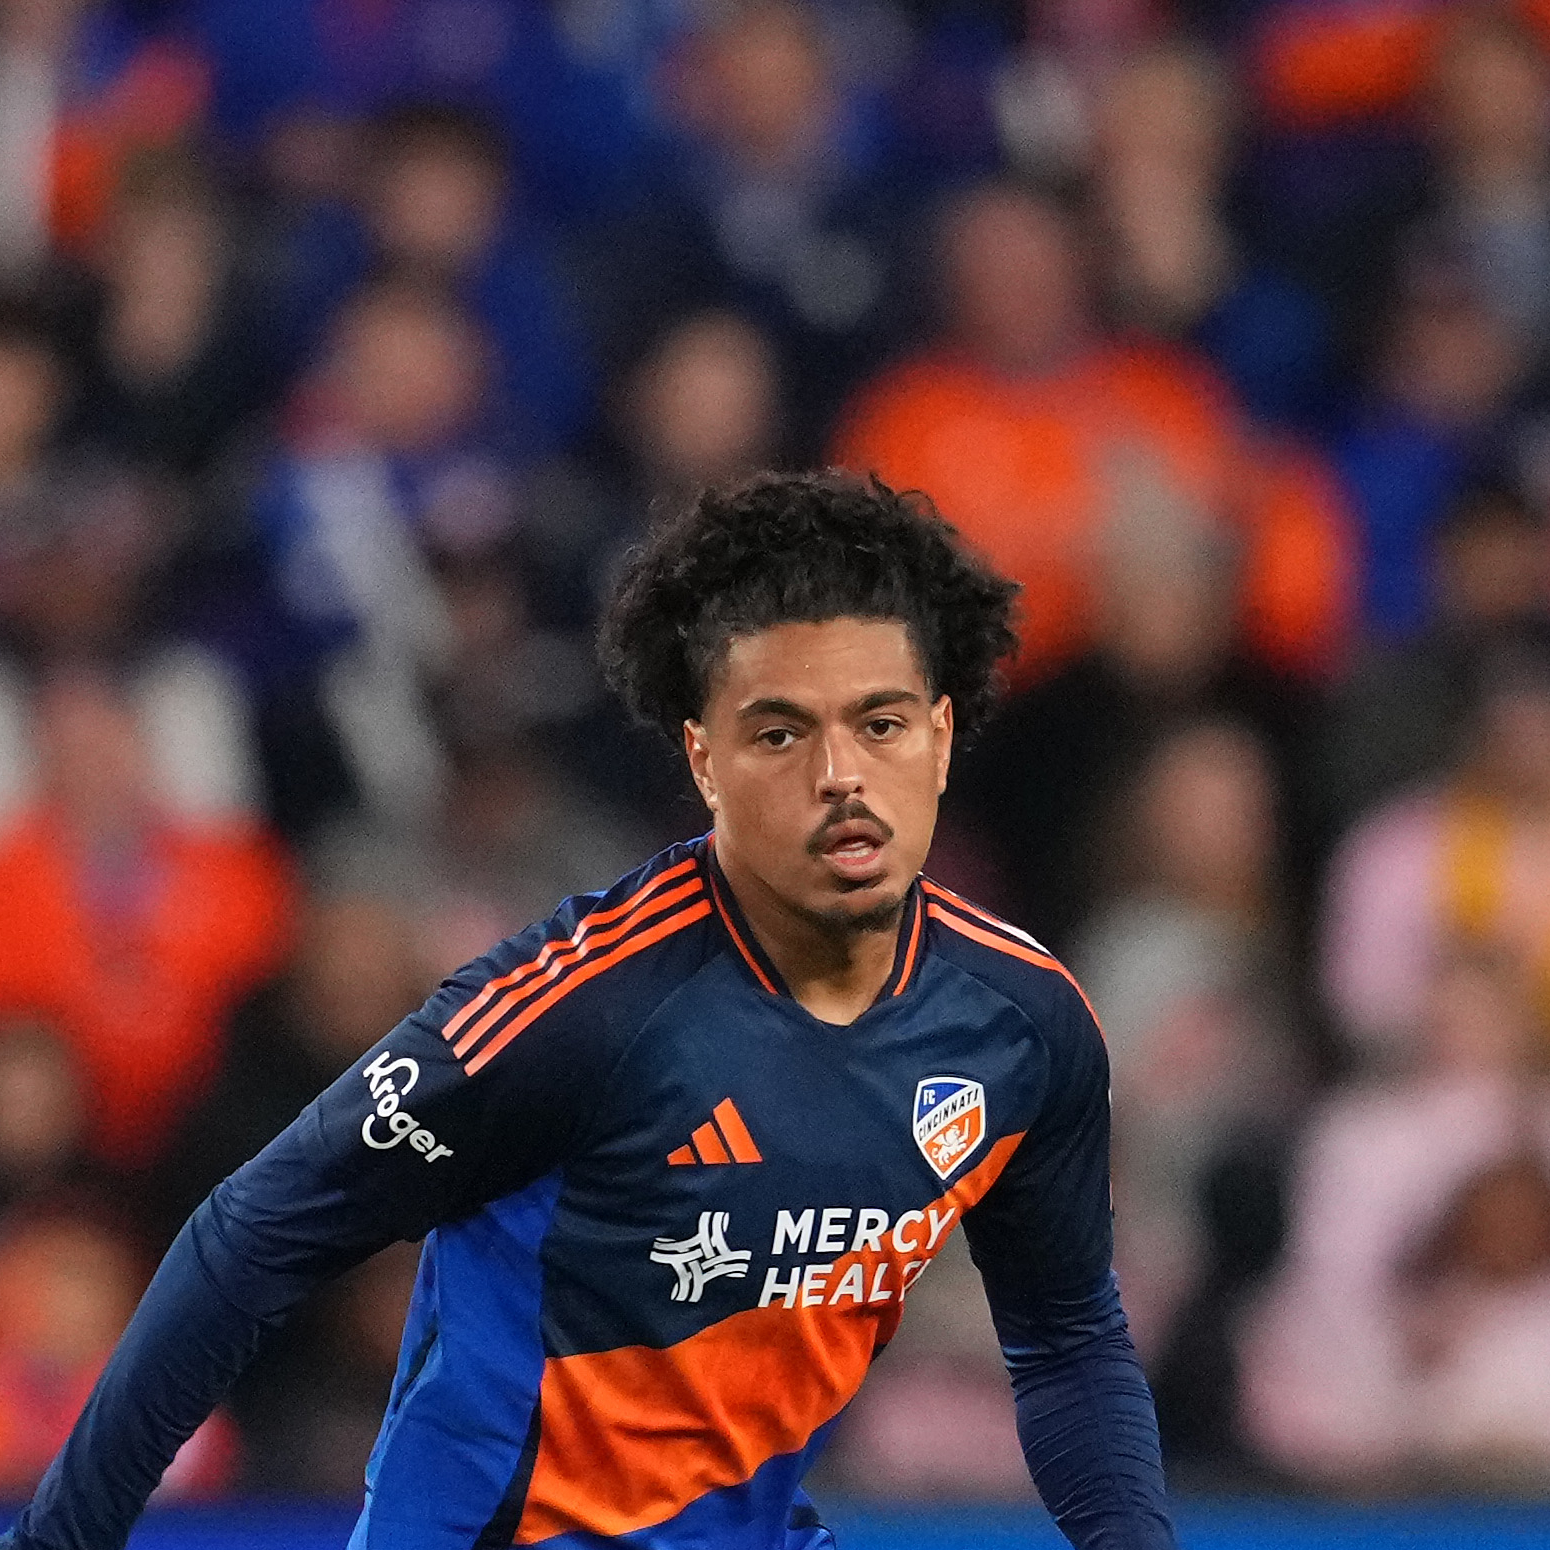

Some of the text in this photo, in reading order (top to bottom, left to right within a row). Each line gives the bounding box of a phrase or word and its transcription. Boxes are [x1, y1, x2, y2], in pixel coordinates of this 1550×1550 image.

[361, 1051, 454, 1163] Kroger
[918, 1088, 979, 1142] CINCINNATI
[923, 1089, 936, 1106] FC
[771, 1207, 957, 1255] MERCY
